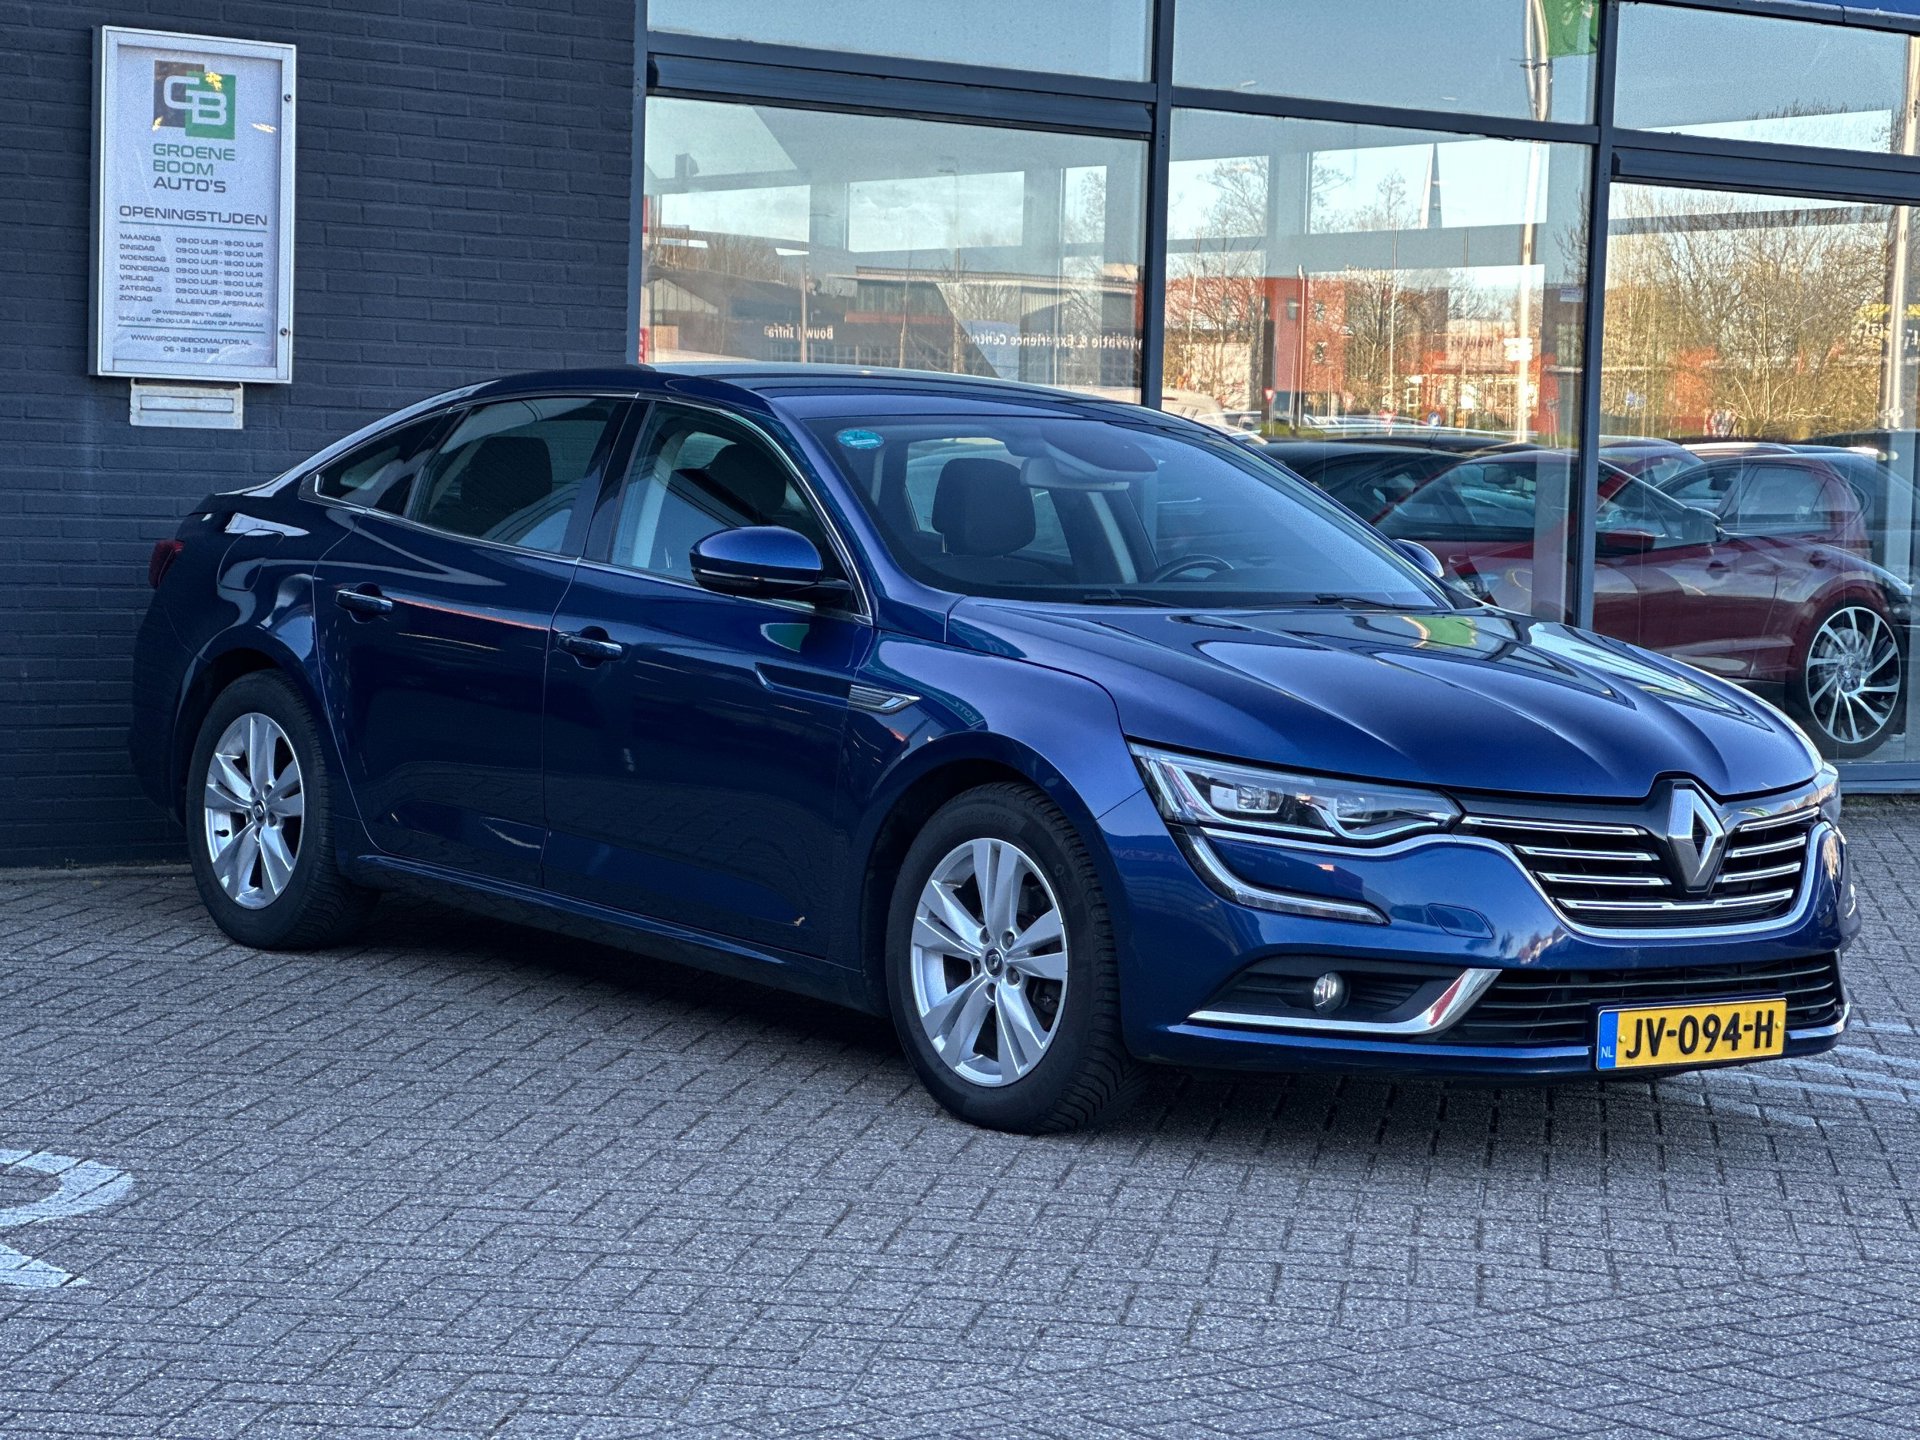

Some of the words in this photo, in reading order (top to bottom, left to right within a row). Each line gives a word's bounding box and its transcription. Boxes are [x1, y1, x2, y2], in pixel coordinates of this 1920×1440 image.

[153, 143, 236, 161] GROENE
[153, 159, 214, 176] BOOM
[153, 176, 226, 193] AUTO'S
[119, 205, 268, 226] OPENINGSTIJDEN
[119, 233, 161, 242] MAANDAG
[245, 241, 264, 249] UUR
[119, 243, 155, 251] DINSDAG
[245, 252, 264, 260] UUR
[119, 254, 166, 262] WOENSDAG
[245, 262, 264, 270] UUR
[119, 264, 170, 273] DONDERDAG
[245, 271, 264, 279] UUR
[119, 274, 154, 282] VRIJDAG
[245, 281, 264, 289] UUR
[119, 284, 162, 292] ZATERDAG
[245, 291, 264, 299] UUR
[119, 294, 153, 302] ZONDAG
[221, 300, 265, 308] AFSPRAAK
[1626, 1009, 1775, 1059] JV-094-H
[1601, 1046, 1615, 1058] NL
